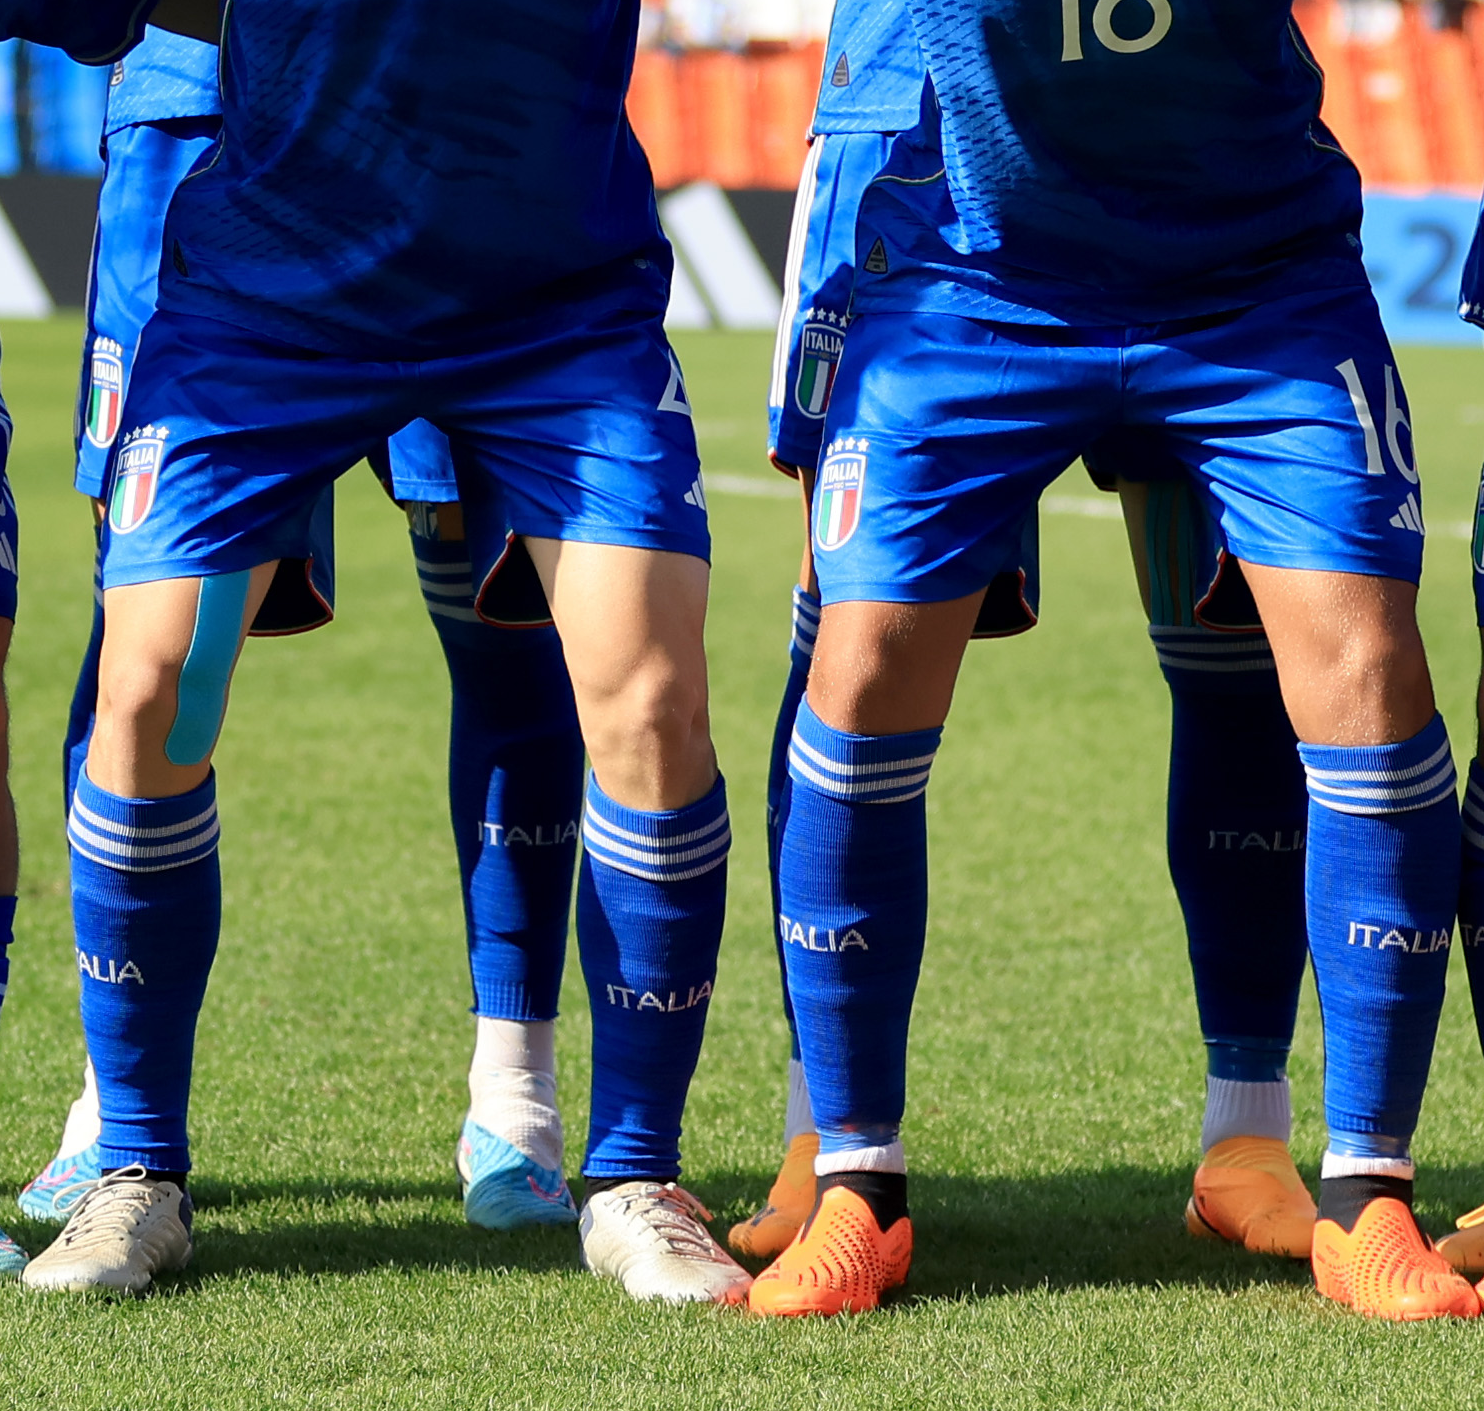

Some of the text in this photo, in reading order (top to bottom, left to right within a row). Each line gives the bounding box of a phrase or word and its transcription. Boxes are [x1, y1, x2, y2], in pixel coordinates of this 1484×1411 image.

[805, 330, 844, 353] ITALIA
[119, 446, 154, 471] ITALIA
[824, 463, 859, 485] ITALIA
[477, 820, 577, 847] ITALIA
[1209, 829, 1305, 851] ITALI
[1348, 921, 1450, 954] ITALIA
[607, 981, 712, 1012] ITALIA
